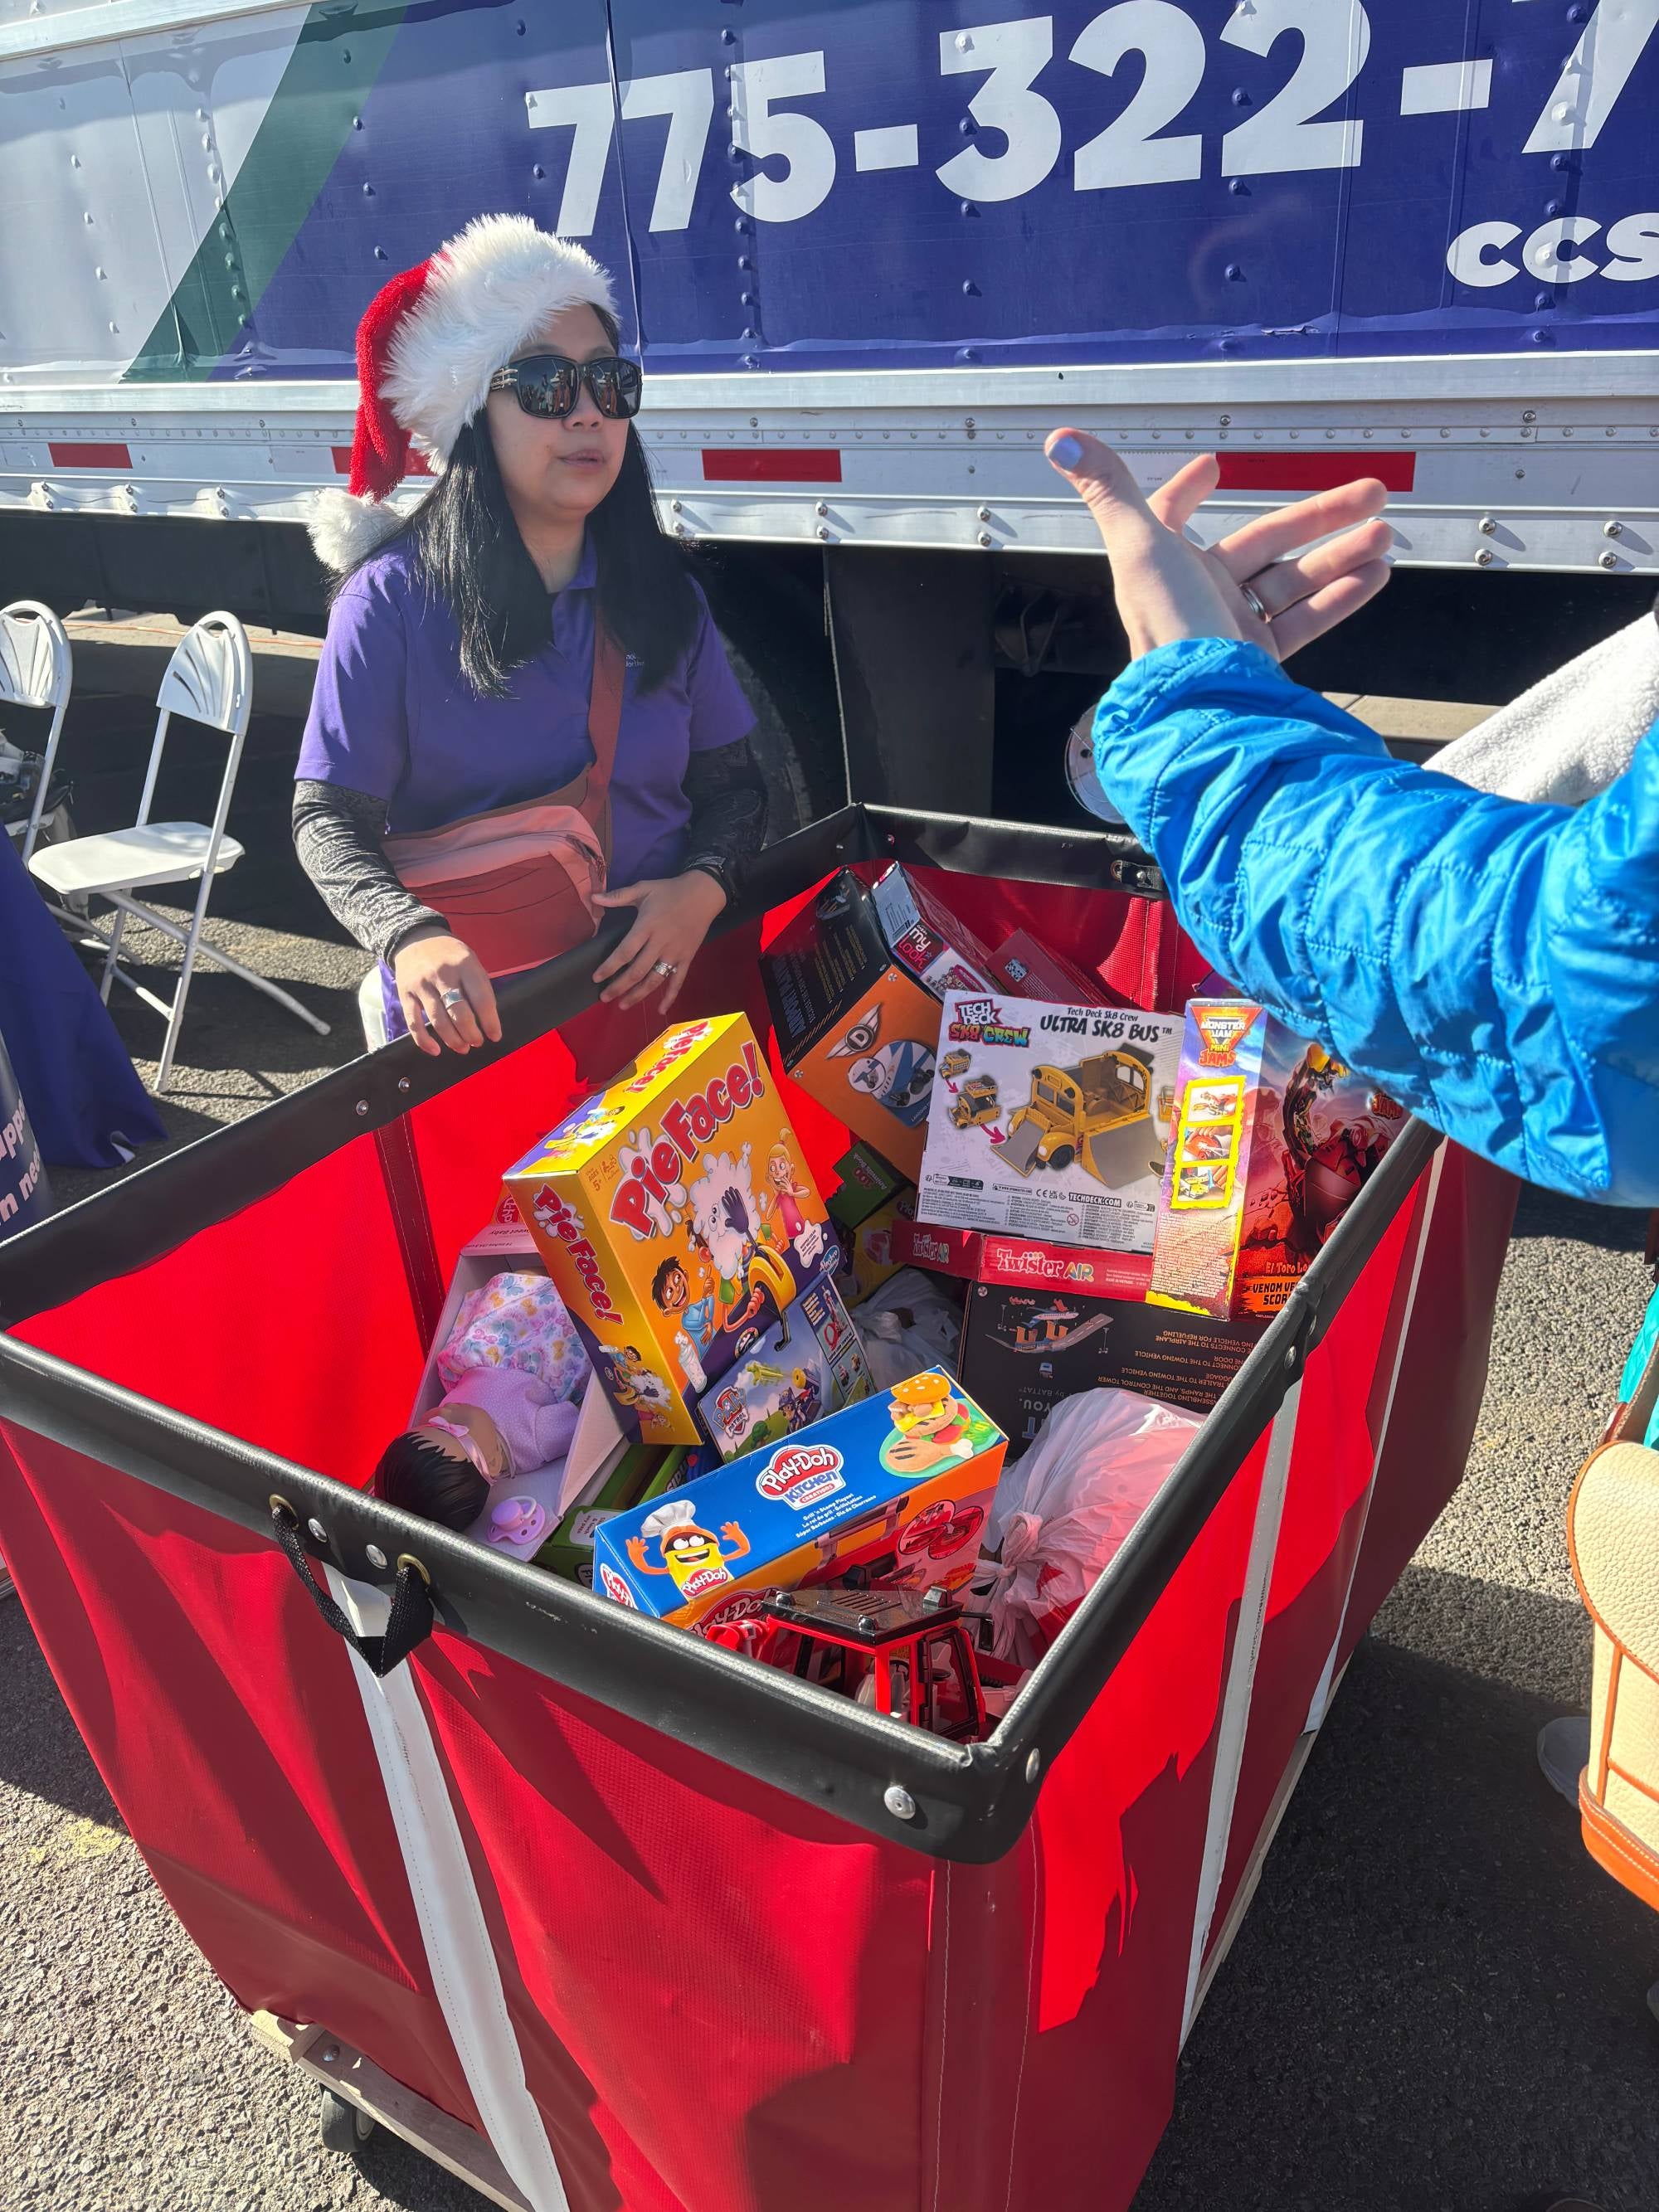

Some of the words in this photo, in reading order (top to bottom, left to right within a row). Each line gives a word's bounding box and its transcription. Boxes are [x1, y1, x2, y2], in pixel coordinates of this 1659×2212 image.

[907, 928, 932, 954] my
[959, 1002, 991, 1015] TECH
[962, 1012, 997, 1025] DECK
[1067, 1007, 1083, 1016] Tech
[1086, 1009, 1102, 1018] Deck
[1120, 1013, 1138, 1022] Crew
[1040, 1014, 1087, 1035] ULTRA
[1092, 1020, 1124, 1038] SK8
[1200, 1021, 1246, 1029] MONSTER
[950, 1023, 979, 1041] SK8
[983, 1025, 1029, 1045] CREW
[1212, 1029, 1233, 1038] JAM
[1199, 1048, 1237, 1067] JAMS
[1069, 1194, 1121, 1208] TECHDECK.COM
[997, 1247, 1064, 1277] Twister
[1063, 1262, 1094, 1282] AIR
[1266, 1262, 1274, 1274] El
[1277, 1262, 1296, 1274] Toro
[1253, 1282, 1282, 1293] VENOM
[1163, 1330, 1199, 1340] REFUELING
[1155, 1335, 1189, 1347] AIRPLANE
[1189, 1339, 1201, 1348] THE
[1213, 1337, 1242, 1345] VEHICLE
[1210, 1343, 1246, 1354] CONNECTS
[1135, 1350, 1161, 1360] VEHICLE
[1161, 1354, 1189, 1364] TOWING
[1214, 1355, 1234, 1364] DOOR
[1189, 1358, 1202, 1366] THE
[1121, 1367, 1148, 1378] VEHICLE
[1148, 1372, 1175, 1381] TOWING
[1098, 1376, 1120, 1385] TOWER
[1175, 1374, 1189, 1383] THE
[1199, 1379, 1225, 1388] TRAILER
[1121, 1379, 1151, 1390] CONTROL
[1151, 1383, 1164, 1392] THE
[1165, 1386, 1179, 1394] AND
[1144, 1389, 1177, 1400] TOGETHER
[761, 1447, 834, 1491] Play-Doh
[683, 1568, 727, 1594] Play-Doh
